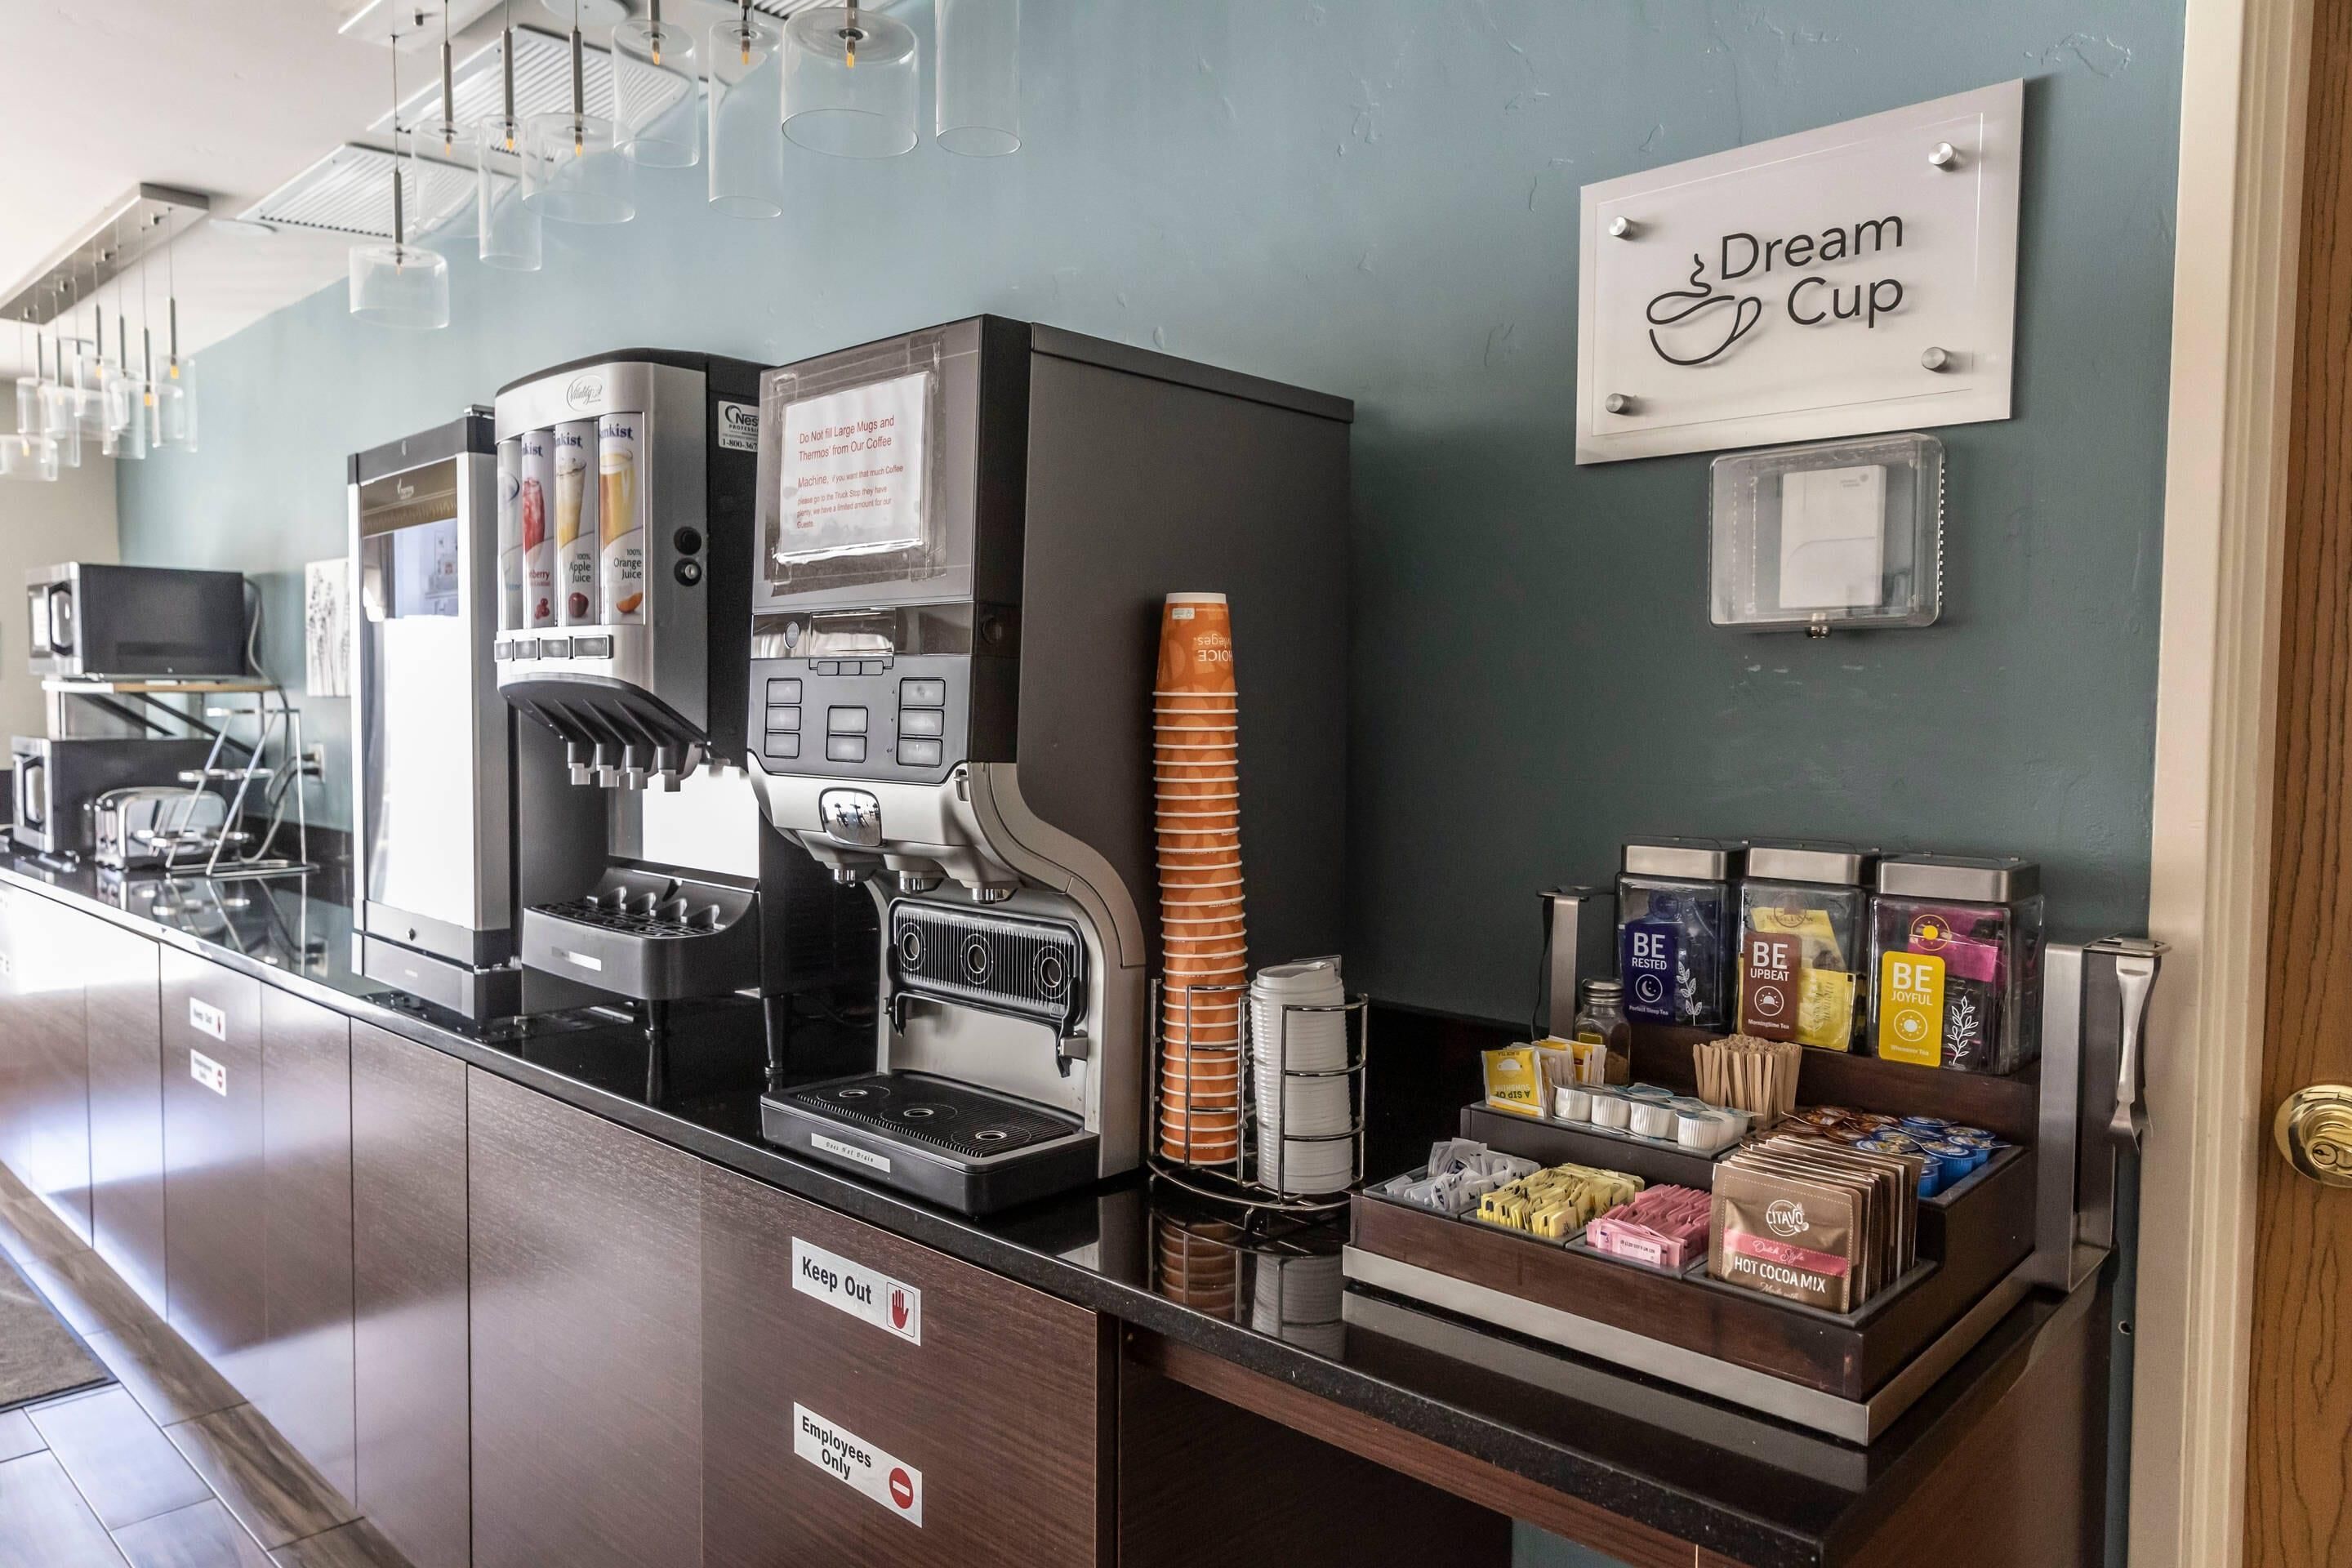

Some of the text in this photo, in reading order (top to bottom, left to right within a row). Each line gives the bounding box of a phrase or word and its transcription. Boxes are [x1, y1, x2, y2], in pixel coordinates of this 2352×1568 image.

[1722, 216, 1903, 280] Dream
[1788, 276, 1903, 329] Cup
[735, 412, 760, 426] Nes
[800, 415, 894, 443] Do Not fill Large Mugs and
[832, 444, 849, 456] from
[850, 440, 864, 452] Our
[866, 436, 892, 449] Coffee
[835, 474, 845, 484] you
[859, 470, 869, 479] that
[870, 468, 884, 477] much
[885, 465, 904, 474] Coffee
[569, 561, 591, 572] Apple
[614, 558, 642, 569] Orange
[572, 572, 591, 583] Juice
[621, 569, 642, 581] Juice
[1633, 932, 1666, 959] BE
[1632, 957, 1667, 970] RESTED
[1753, 941, 1788, 969] BE
[1750, 968, 1790, 982] UPBEAT
[1893, 962, 1933, 993] BE
[1891, 991, 1933, 1006] JOYFUL
[1508, 1090, 1523, 1098] SIP
[1524, 1090, 1530, 1098] A
[1766, 1209, 1803, 1227] CITAVO
[1780, 1248, 1805, 1263] Style
[802, 1255, 872, 1305] Keep Out
[1734, 1256, 1826, 1293] HOT COCOA MIX
[802, 1415, 872, 1468] Employees
[822, 1448, 851, 1481] Only
